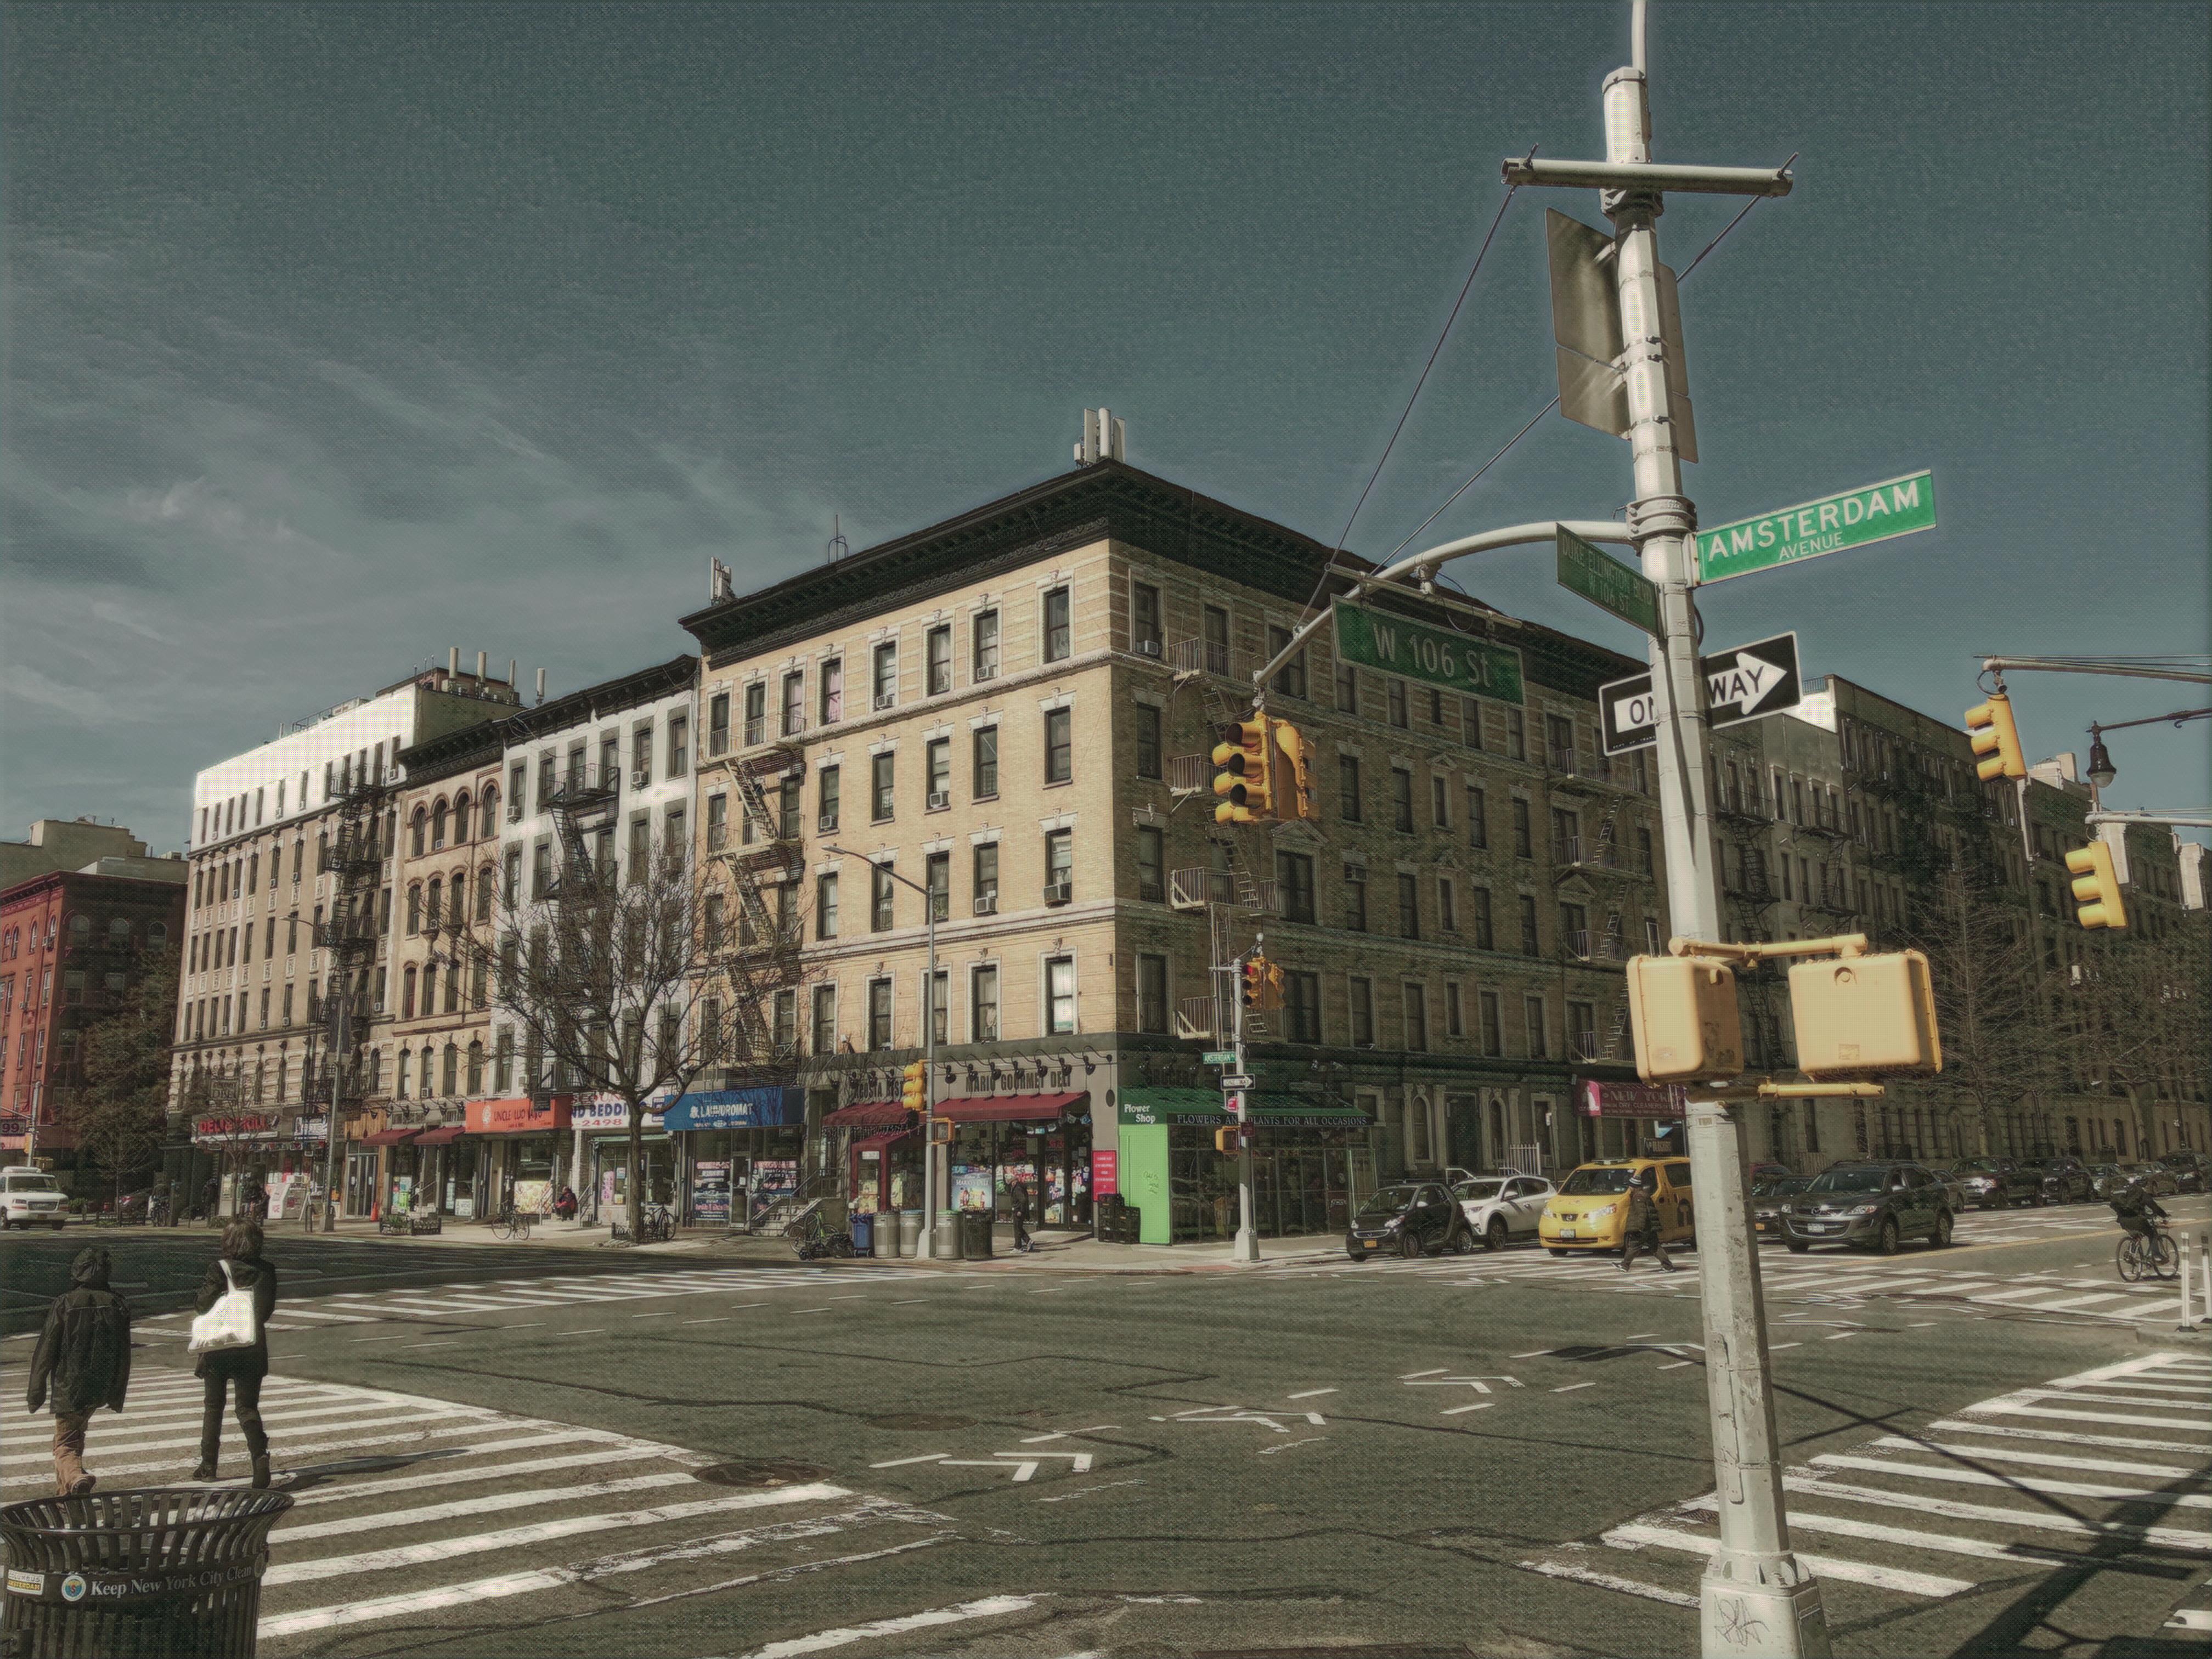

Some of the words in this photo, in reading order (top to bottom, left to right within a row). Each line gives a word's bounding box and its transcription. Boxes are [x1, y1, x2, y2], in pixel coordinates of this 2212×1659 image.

[1708, 481, 1920, 562] AMSTERDAM
[1779, 532, 1845, 561] AVENUE
[1563, 534, 1585, 567] DUKE
[1588, 549, 1630, 594] ELLINGTON
[1633, 578, 1652, 606] BLVD
[1588, 573, 1595, 596] W
[1600, 580, 1616, 607] 106
[1619, 592, 1629, 615] ST
[1374, 622, 1396, 662] W
[1409, 634, 1455, 678] 106
[1466, 649, 1491, 688] St
[1707, 665, 1764, 705] WAY
[965, 1074, 996, 1092] MARIO
[1000, 1071, 1044, 1091] GOURMET
[1050, 1070, 1070, 1088] DELI
[1124, 1103, 1150, 1113] Flower
[1611, 1091, 1638, 1102] NEW
[572, 1104, 585, 1118] ND
[590, 1101, 645, 1118] BEDDI
[701, 1103, 754, 1118] LAUNDROMAT
[1135, 1113, 1156, 1124] Shop
[1177, 1114, 1221, 1124] FLOWERS
[1225, 1115, 1240, 1125] AN
[1283, 1117, 1300, 1125] FOR
[1304, 1117, 1318, 1125] ALL
[1321, 1116, 1367, 1125] OCCASIONS
[91, 1581, 127, 1598] Keep
[131, 1579, 162, 1594] New
[166, 1574, 196, 1590] York
[200, 1570, 224, 1587] City
[226, 1565, 252, 1581] Clean
